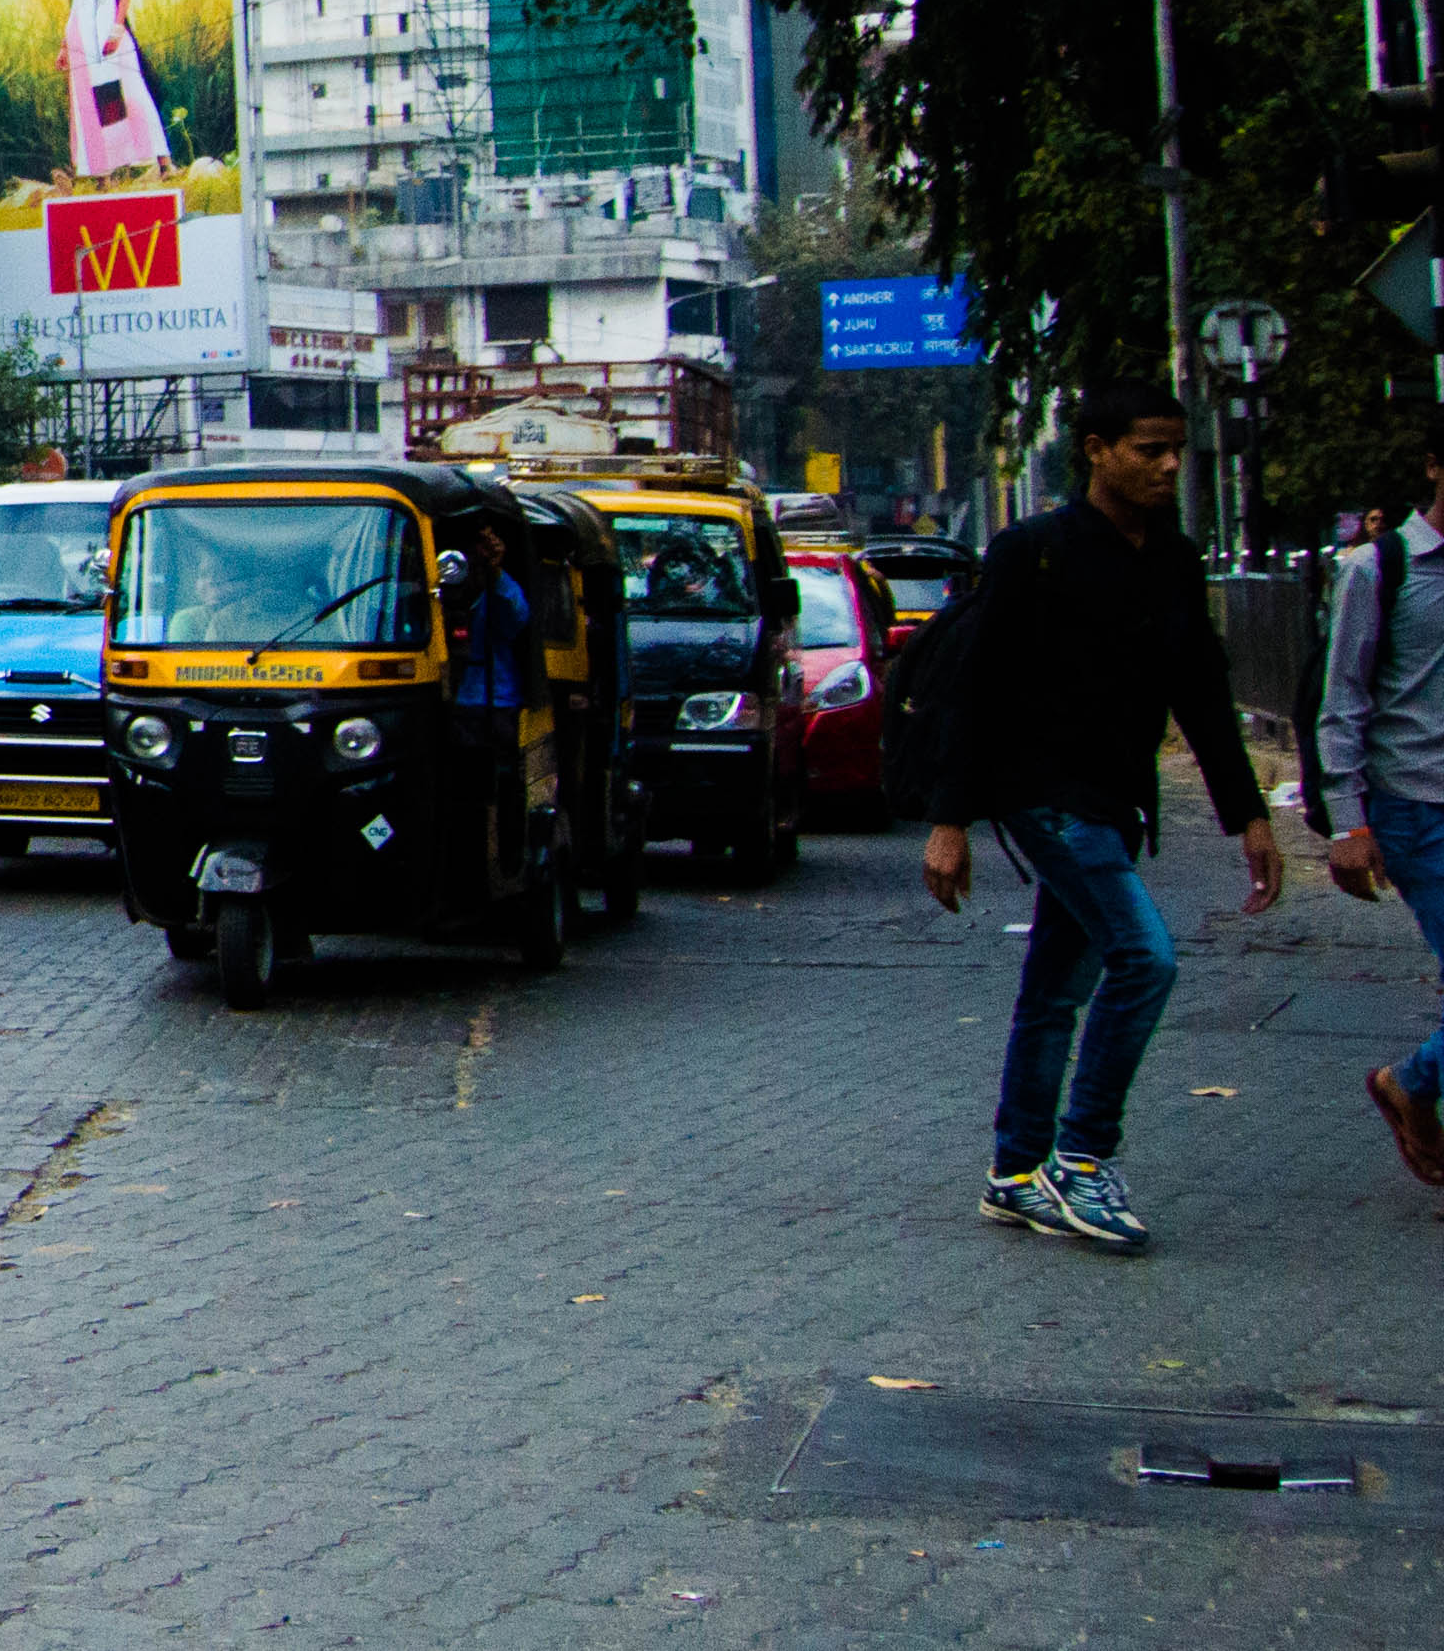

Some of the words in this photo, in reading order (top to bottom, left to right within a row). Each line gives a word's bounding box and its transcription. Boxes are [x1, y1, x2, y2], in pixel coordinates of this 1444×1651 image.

[842, 290, 895, 306] ANDHERI
[159, 307, 228, 331] KURTA
[843, 317, 877, 332] JUHU
